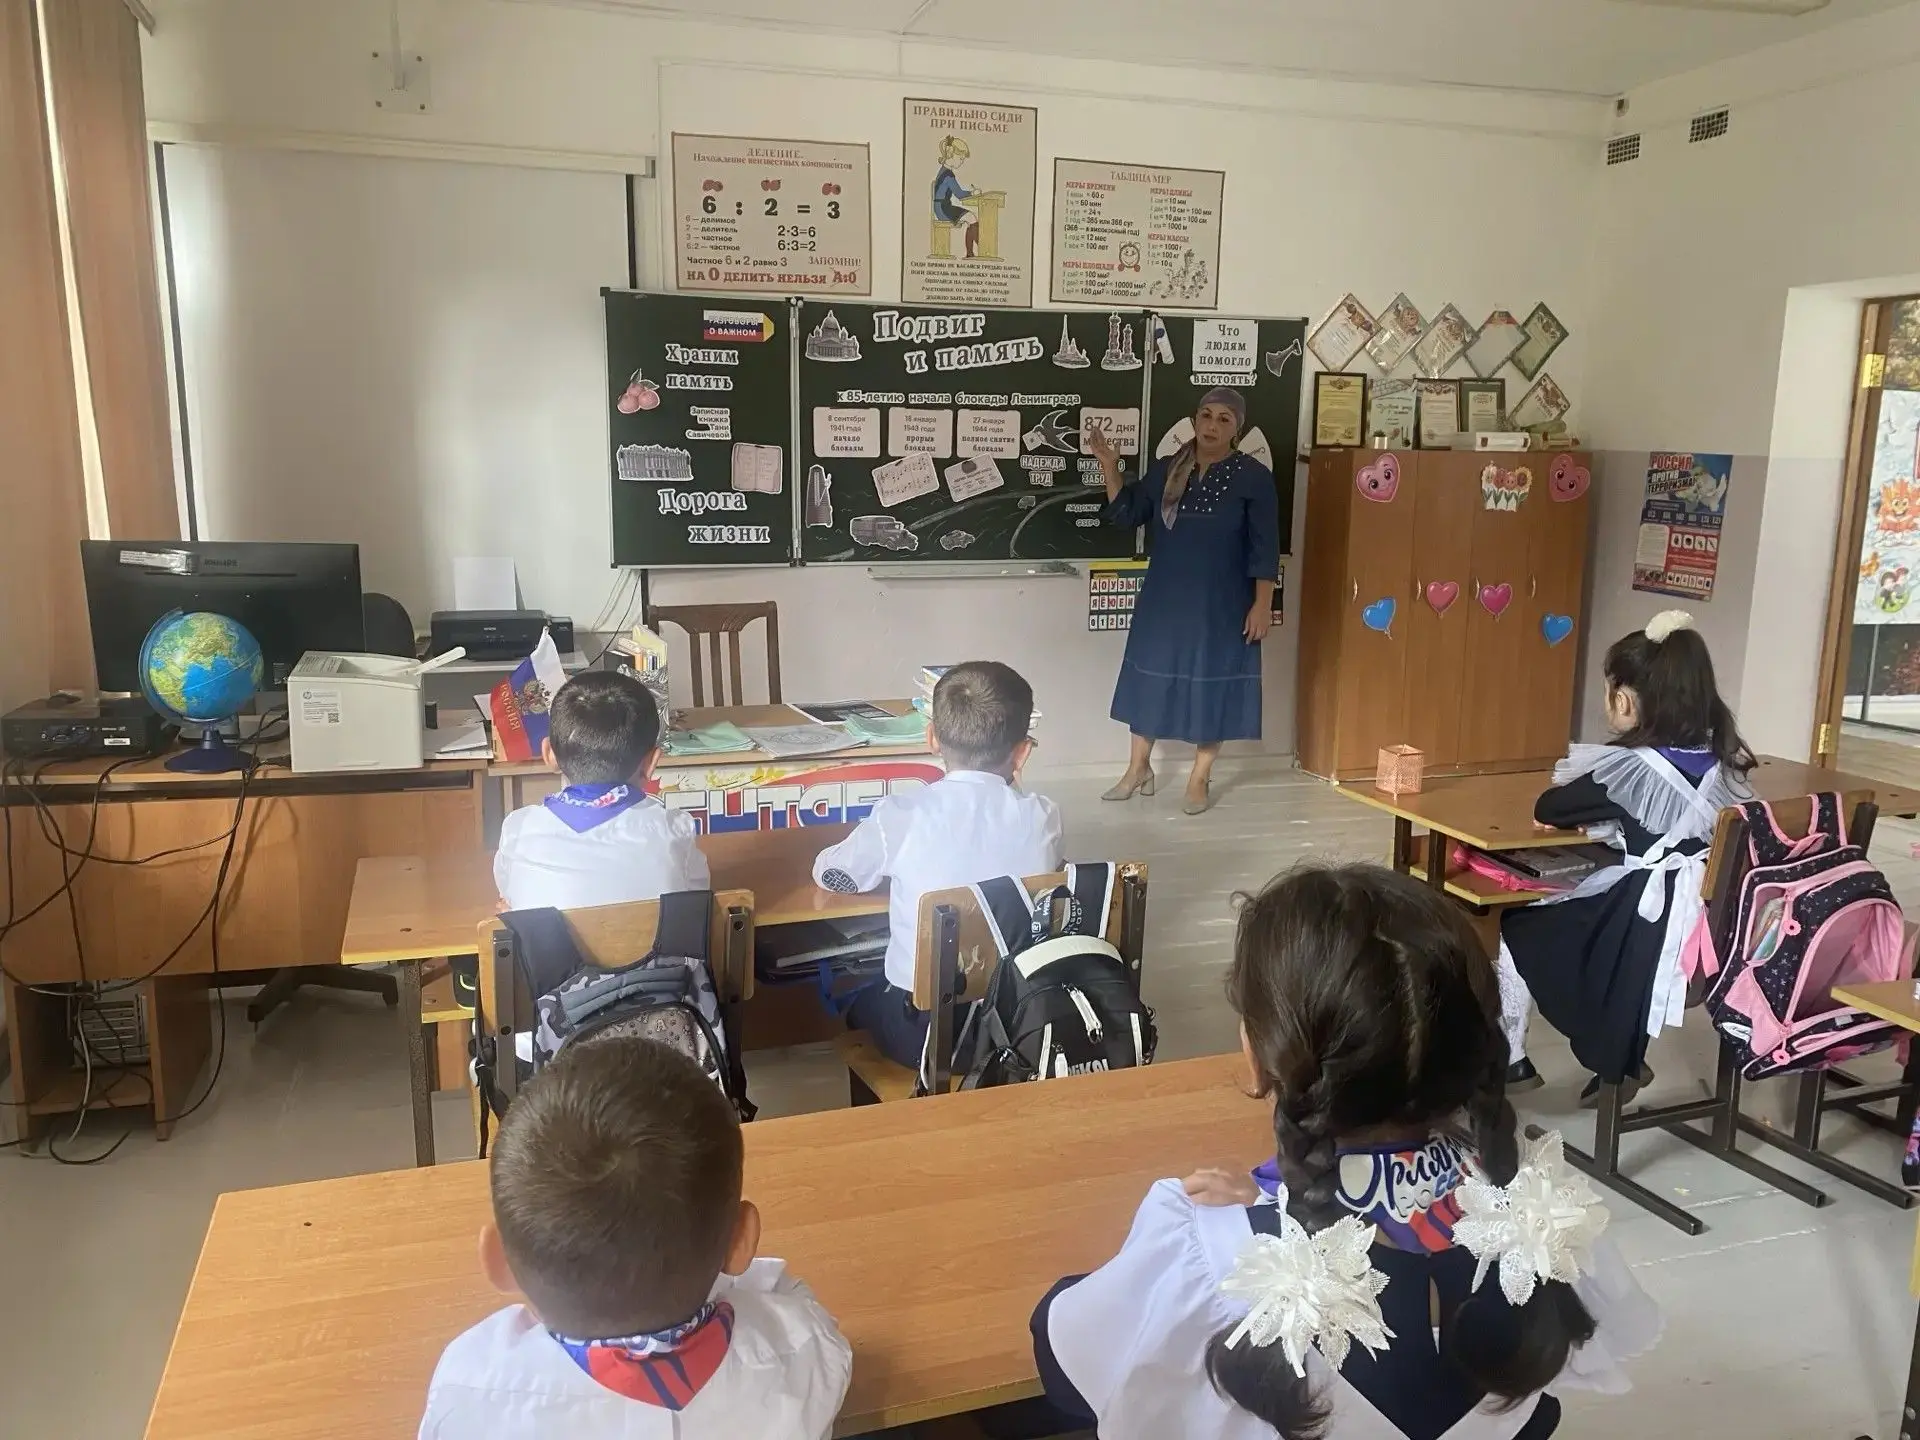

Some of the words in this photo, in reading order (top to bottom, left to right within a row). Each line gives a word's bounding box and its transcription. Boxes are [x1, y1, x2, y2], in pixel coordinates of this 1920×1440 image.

[913, 106, 988, 119] ПРАВИЛЬНО
[990, 112, 1023, 124] СИДИ
[930, 119, 956, 129] ПРИ
[960, 120, 1009, 134] ПИСЬМЕ
[693, 153, 746, 164] Нахождение
[747, 148, 804, 158] ДЕЛЕНИЕ.
[1111, 171, 1152, 182] ТАБЛИЦА
[1153, 174, 1172, 184] МЕР
[702, 196, 717, 214] 6
[764, 198, 778, 216] 2
[827, 201, 840, 219] 3
[700, 226, 738, 234] делитель
[687, 256, 723, 265] Частное
[725, 255, 733, 265] 6
[743, 256, 750, 266] 2
[753, 259, 778, 268] равно
[780, 257, 788, 266] 3
[808, 256, 862, 267] ЗАПОМНИ!
[687, 270, 706, 281] НА
[724, 270, 774, 283] ДЕЛИТЬ
[777, 273, 827, 284] НЕЛЬЗЯ
[708, 316, 760, 326] РАЗГОВОРЫ
[876, 313, 985, 340] Подвиг
[717, 328, 757, 336] ВАЖНОМ
[1218, 324, 1240, 336] Что
[1204, 341, 1246, 351] людям
[666, 345, 738, 364] Храним
[908, 354, 926, 372] и
[938, 339, 1041, 369] память
[1199, 356, 1251, 367] помогло
[667, 375, 732, 390] память
[1193, 373, 1257, 385] выстоять?
[838, 392, 845, 401] к
[847, 391, 904, 402] 85-летию
[910, 393, 951, 403] начала
[956, 392, 1008, 405] блокады
[1012, 393, 1080, 406] Ленинграда
[690, 408, 729, 416] Записная
[912, 416, 937, 424] января
[1084, 416, 1113, 432] 872
[1116, 424, 1136, 433] дня
[686, 430, 730, 438] Савичевой
[906, 435, 935, 443] прорыв
[989, 436, 1016, 444] снятие
[1083, 437, 1135, 446] мества
[830, 444, 864, 452] блокады
[904, 444, 936, 452] блокады
[972, 444, 1004, 453] блокады
[1021, 457, 1066, 470] НАДЕЖДА
[1652, 455, 1693, 470] РОССИЯ
[1030, 472, 1052, 486] ТРУД
[1652, 470, 1679, 482] ПРОТИВ
[660, 490, 746, 513] Дорога
[690, 527, 769, 542] жизни
[500, 682, 521, 731] РОССИЯ
